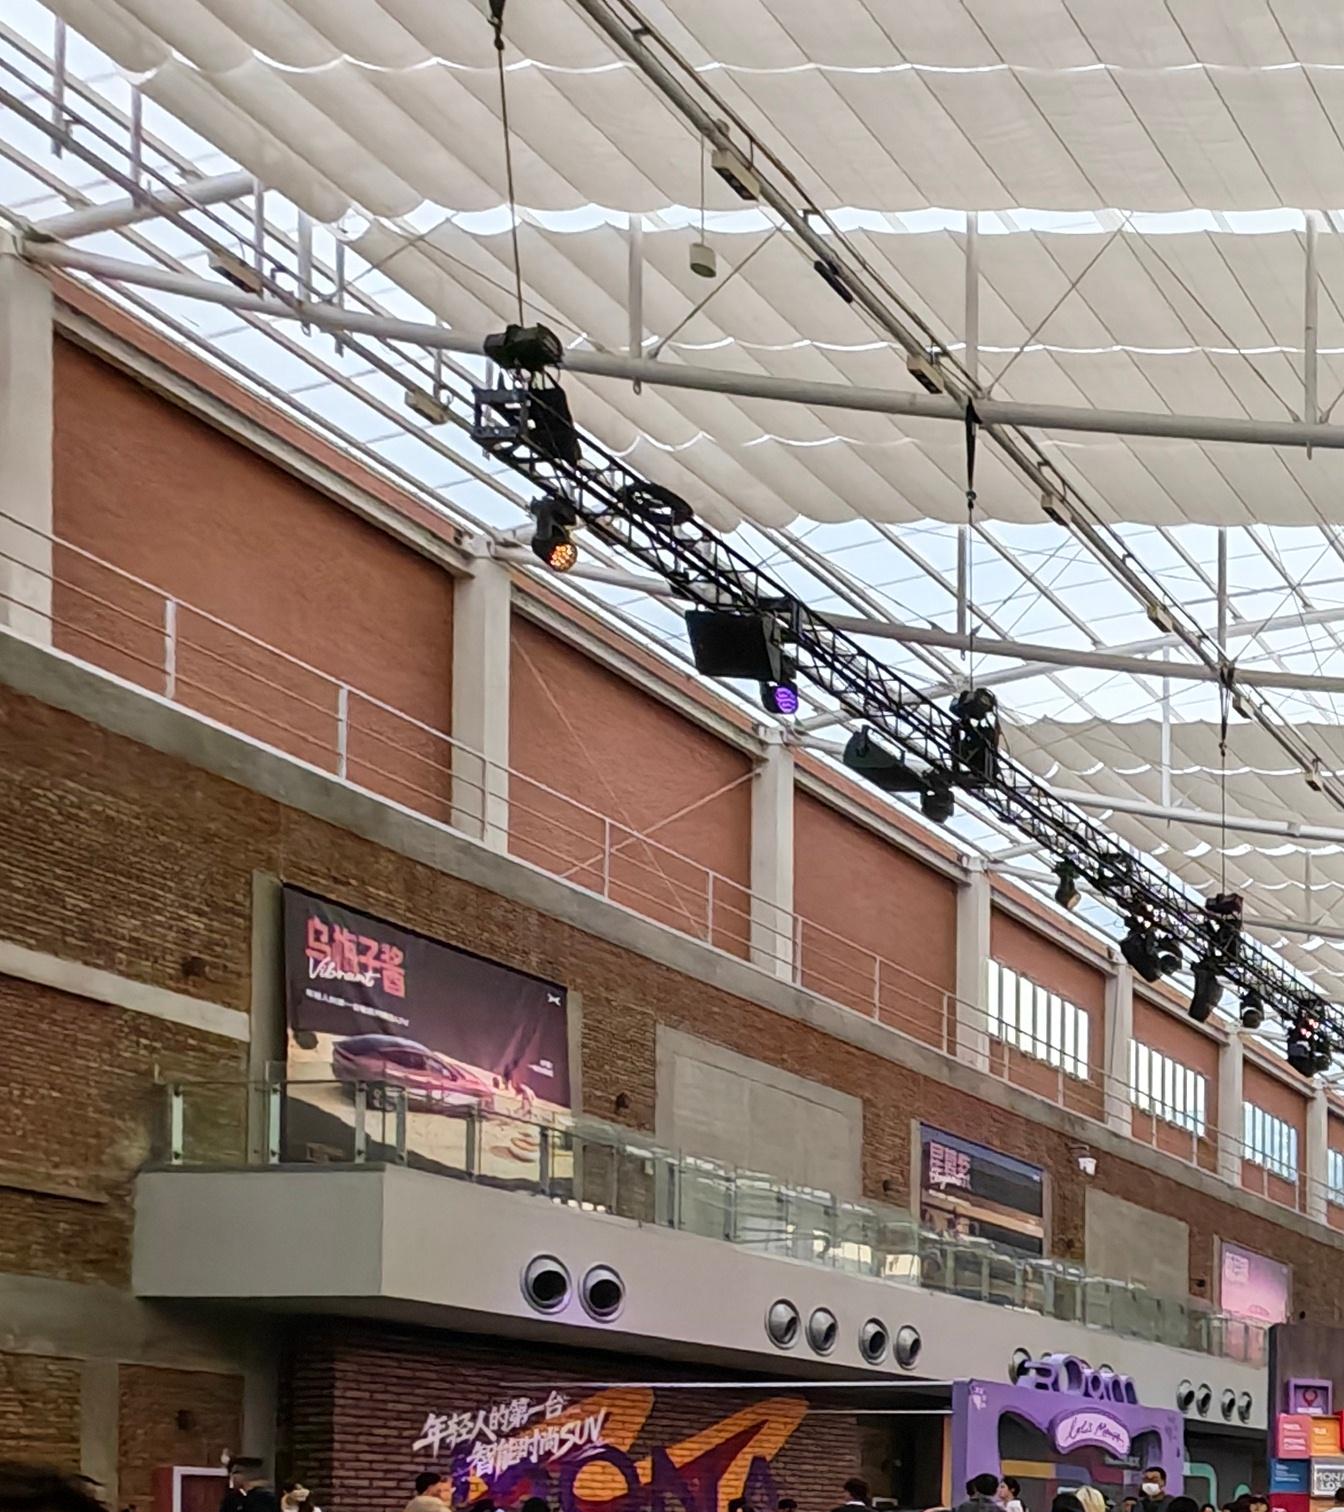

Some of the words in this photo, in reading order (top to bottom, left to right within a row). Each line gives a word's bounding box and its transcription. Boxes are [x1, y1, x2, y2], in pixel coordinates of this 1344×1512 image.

[304, 914, 406, 999] 乌梅子酱
[307, 955, 382, 988] Vibrant
[411, 1389, 571, 1458] 年轻人的第一台
[466, 1406, 608, 1481] 智能时尚SUV
